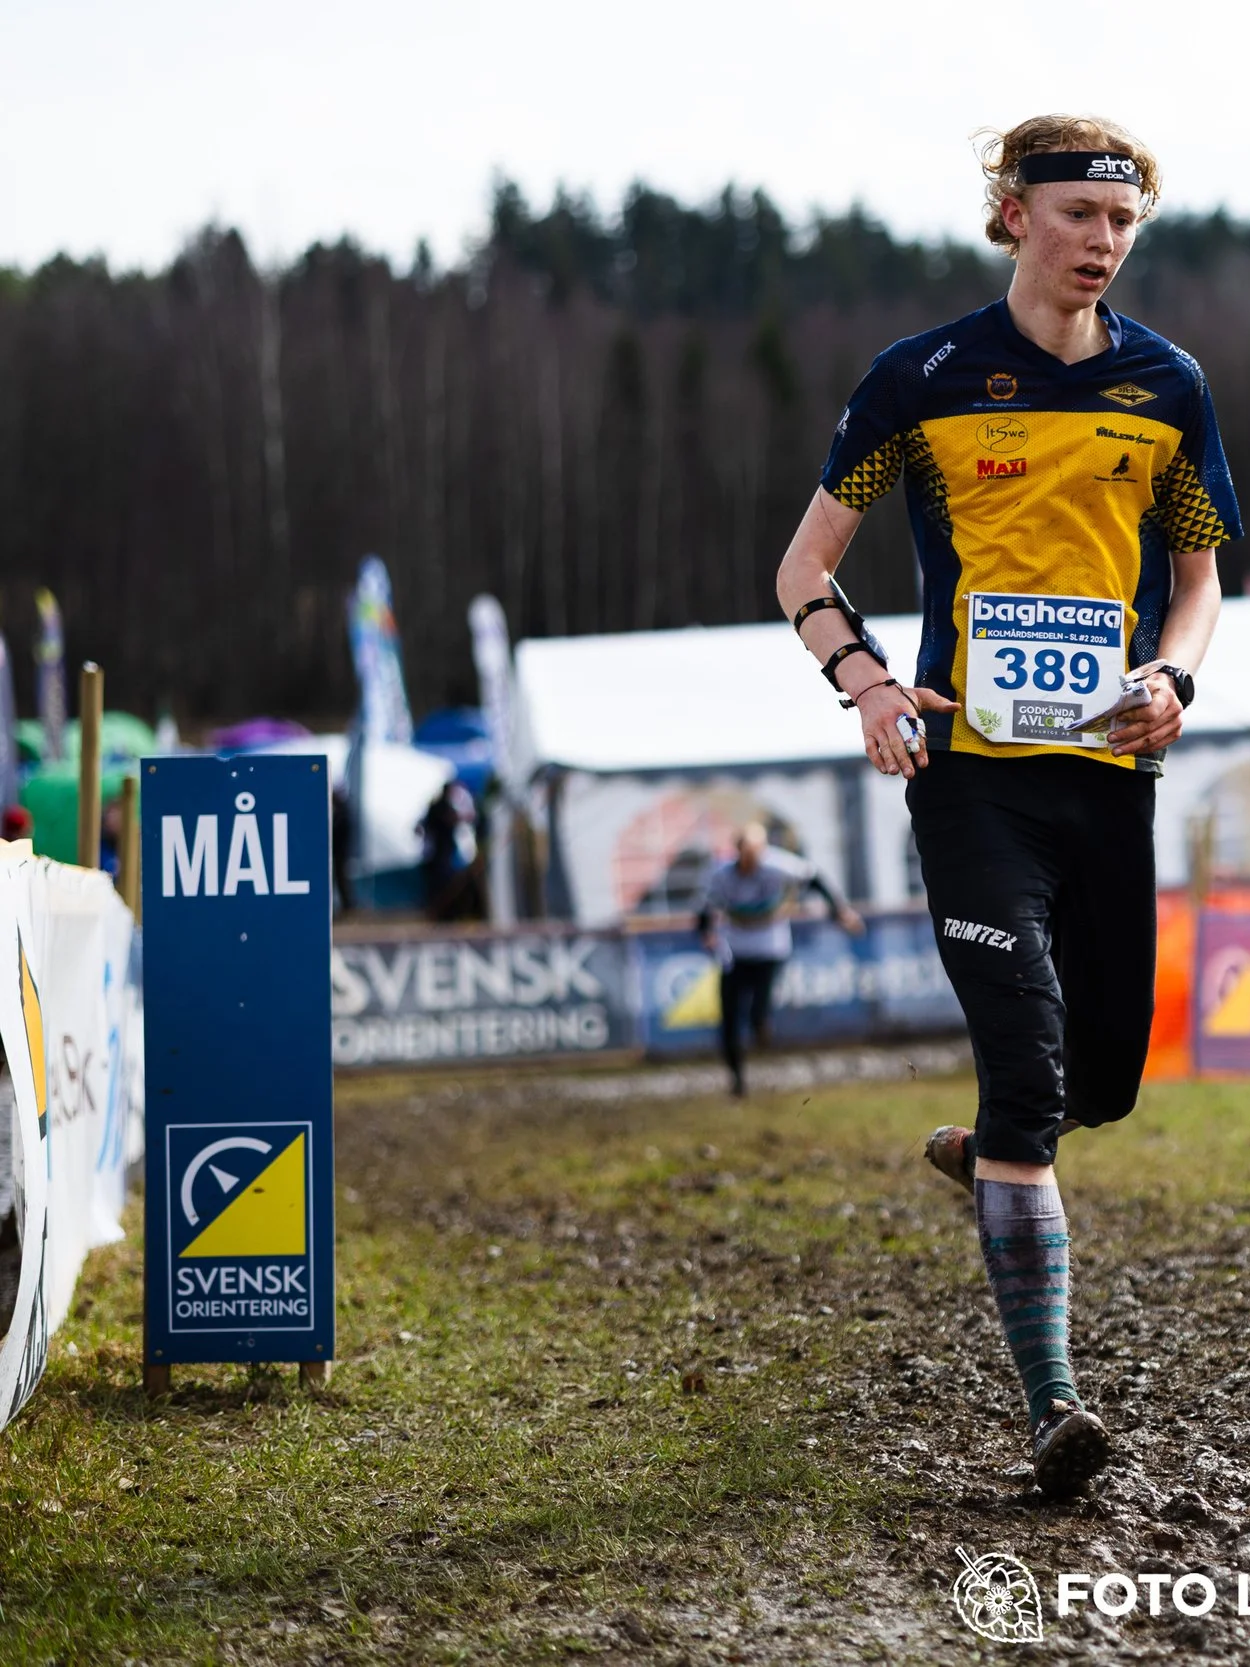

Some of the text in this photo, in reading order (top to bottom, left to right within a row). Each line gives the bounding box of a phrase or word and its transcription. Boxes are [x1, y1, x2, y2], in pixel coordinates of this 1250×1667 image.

[922, 341, 956, 378] ATEX
[974, 598, 1121, 629] bagheera
[987, 628, 1064, 641] KOLMÅRDSMEDELN
[1069, 634, 1079, 642] SL
[1079, 635, 1089, 643] #2
[1090, 635, 1108, 644] 2026
[993, 647, 1100, 695] 389
[1019, 705, 1076, 718] GODKÄNDA
[162, 791, 310, 898] MÅL
[944, 918, 1017, 951] TRIMTEX
[331, 934, 601, 1016] SVENSK
[176, 1265, 308, 1296] SVENSK
[175, 1298, 309, 1318] ORIENTERING
